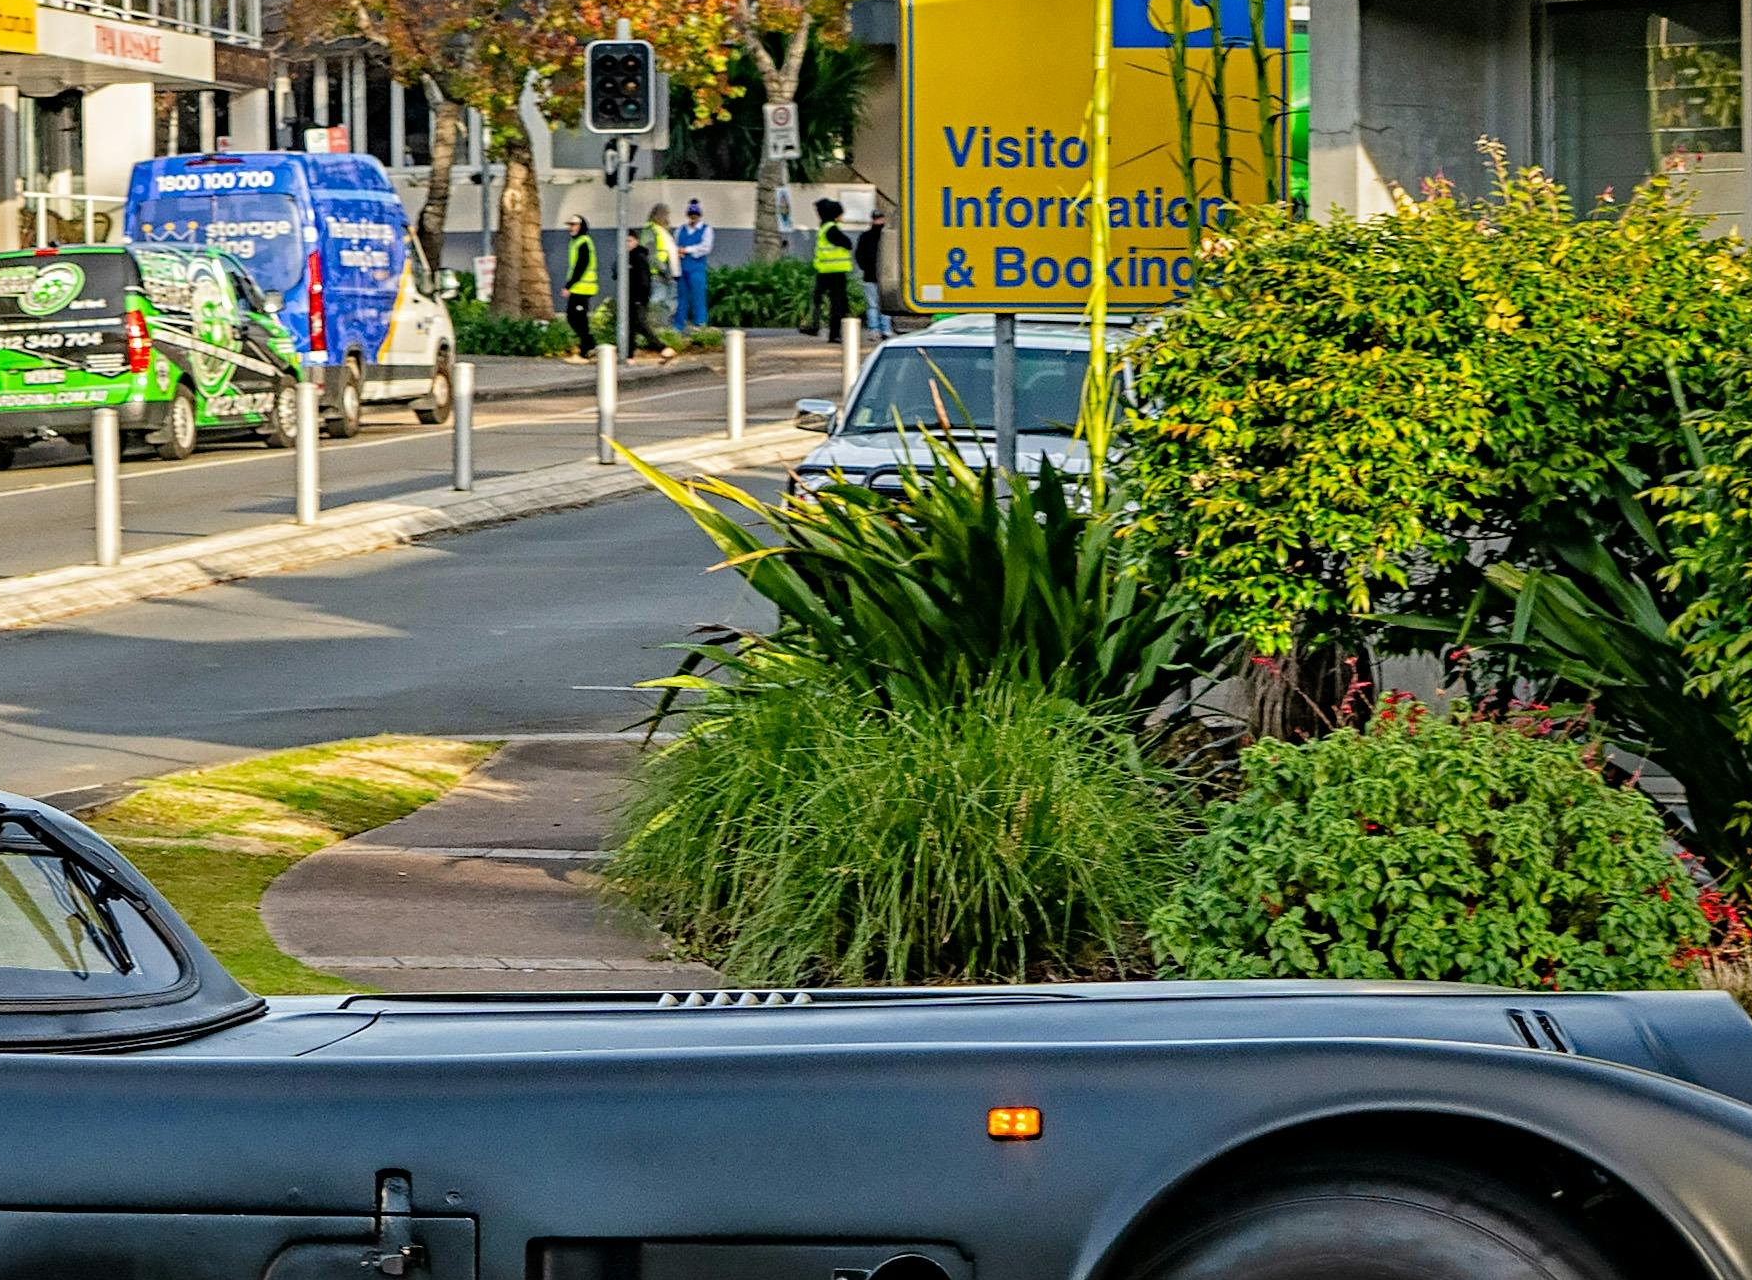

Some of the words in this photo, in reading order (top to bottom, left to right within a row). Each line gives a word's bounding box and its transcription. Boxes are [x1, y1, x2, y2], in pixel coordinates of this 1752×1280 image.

[942, 125, 1108, 169] Visito
[156, 173, 200, 192] 1800
[202, 171, 236, 191] 100
[236, 170, 275, 189] 700
[205, 220, 292, 240] storage
[943, 246, 976, 288] &
[24, 333, 64, 349] 340
[65, 331, 104, 348] 704
